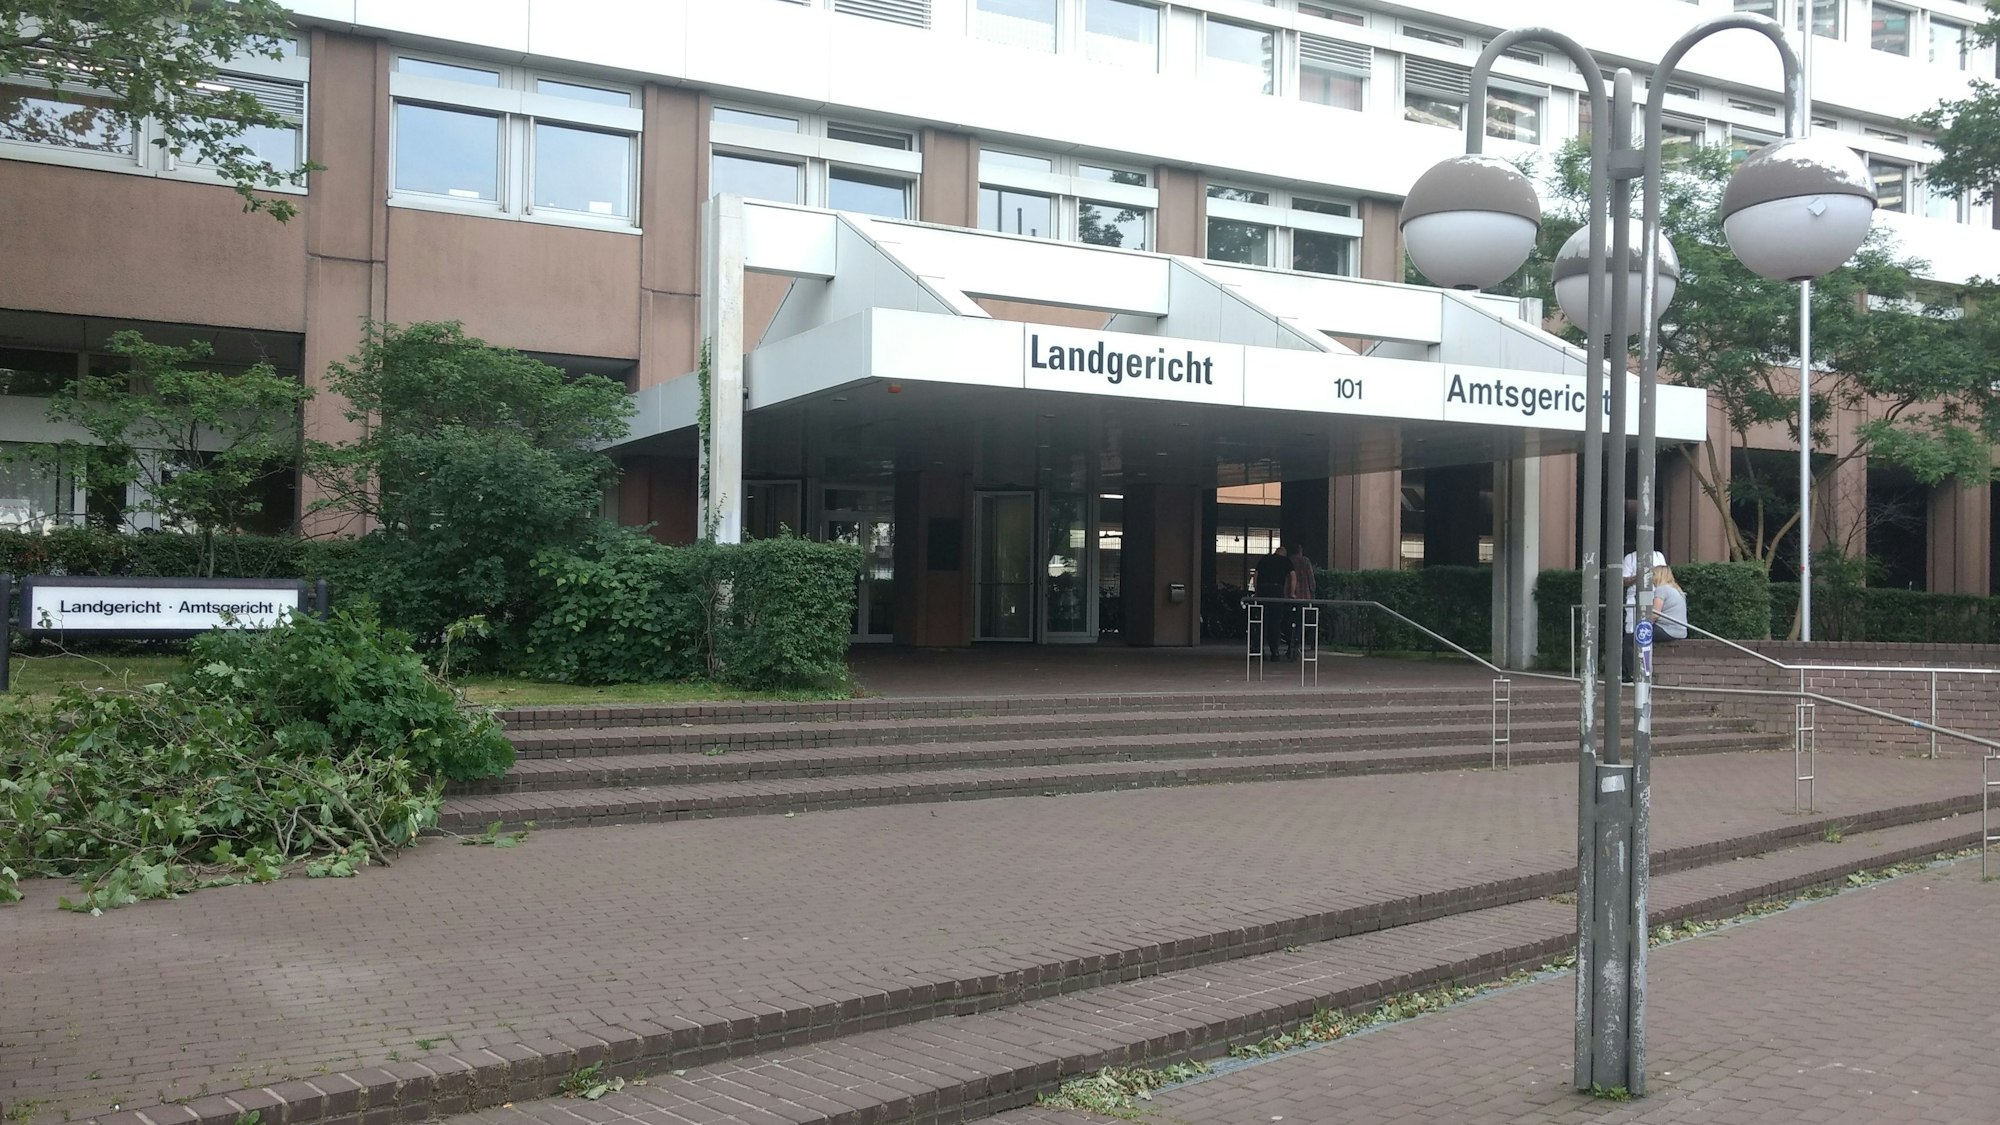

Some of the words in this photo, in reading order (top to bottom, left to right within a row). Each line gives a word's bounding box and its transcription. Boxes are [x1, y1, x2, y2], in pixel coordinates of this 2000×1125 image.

[1031, 334, 1213, 385] Landgericht
[1333, 378, 1362, 400] 101
[1447, 374, 1611, 416] Amtsgerict
[60, 600, 162, 615] Landgericht
[178, 600, 274, 615] Amtsgericht
